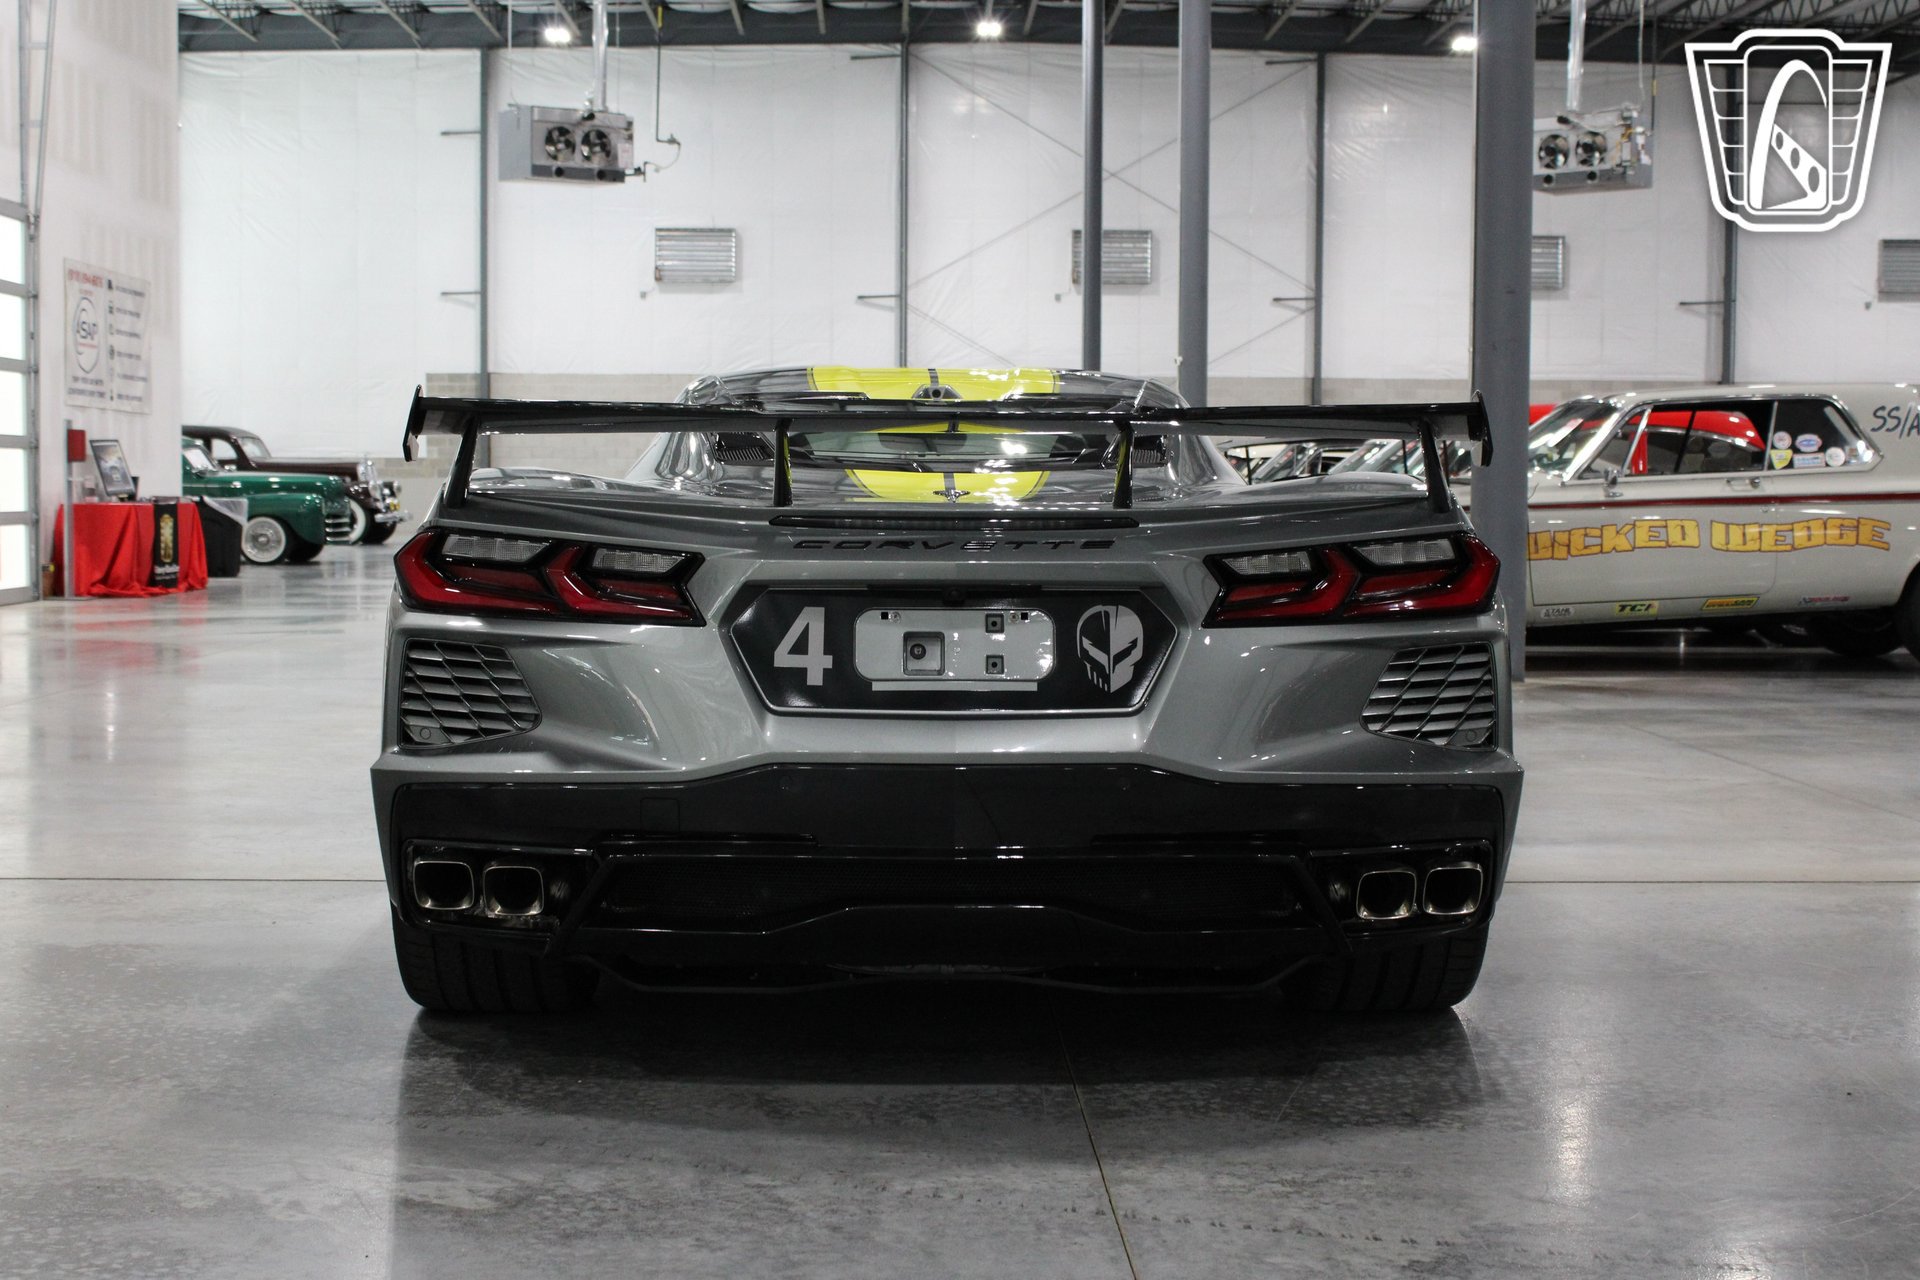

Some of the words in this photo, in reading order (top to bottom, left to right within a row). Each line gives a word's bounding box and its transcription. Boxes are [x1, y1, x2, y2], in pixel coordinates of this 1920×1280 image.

[1870, 405, 1920, 439] SS/A
[793, 540, 1115, 550] CORVETTE
[1710, 517, 1891, 552] WEDGE
[773, 606, 833, 686] 4
